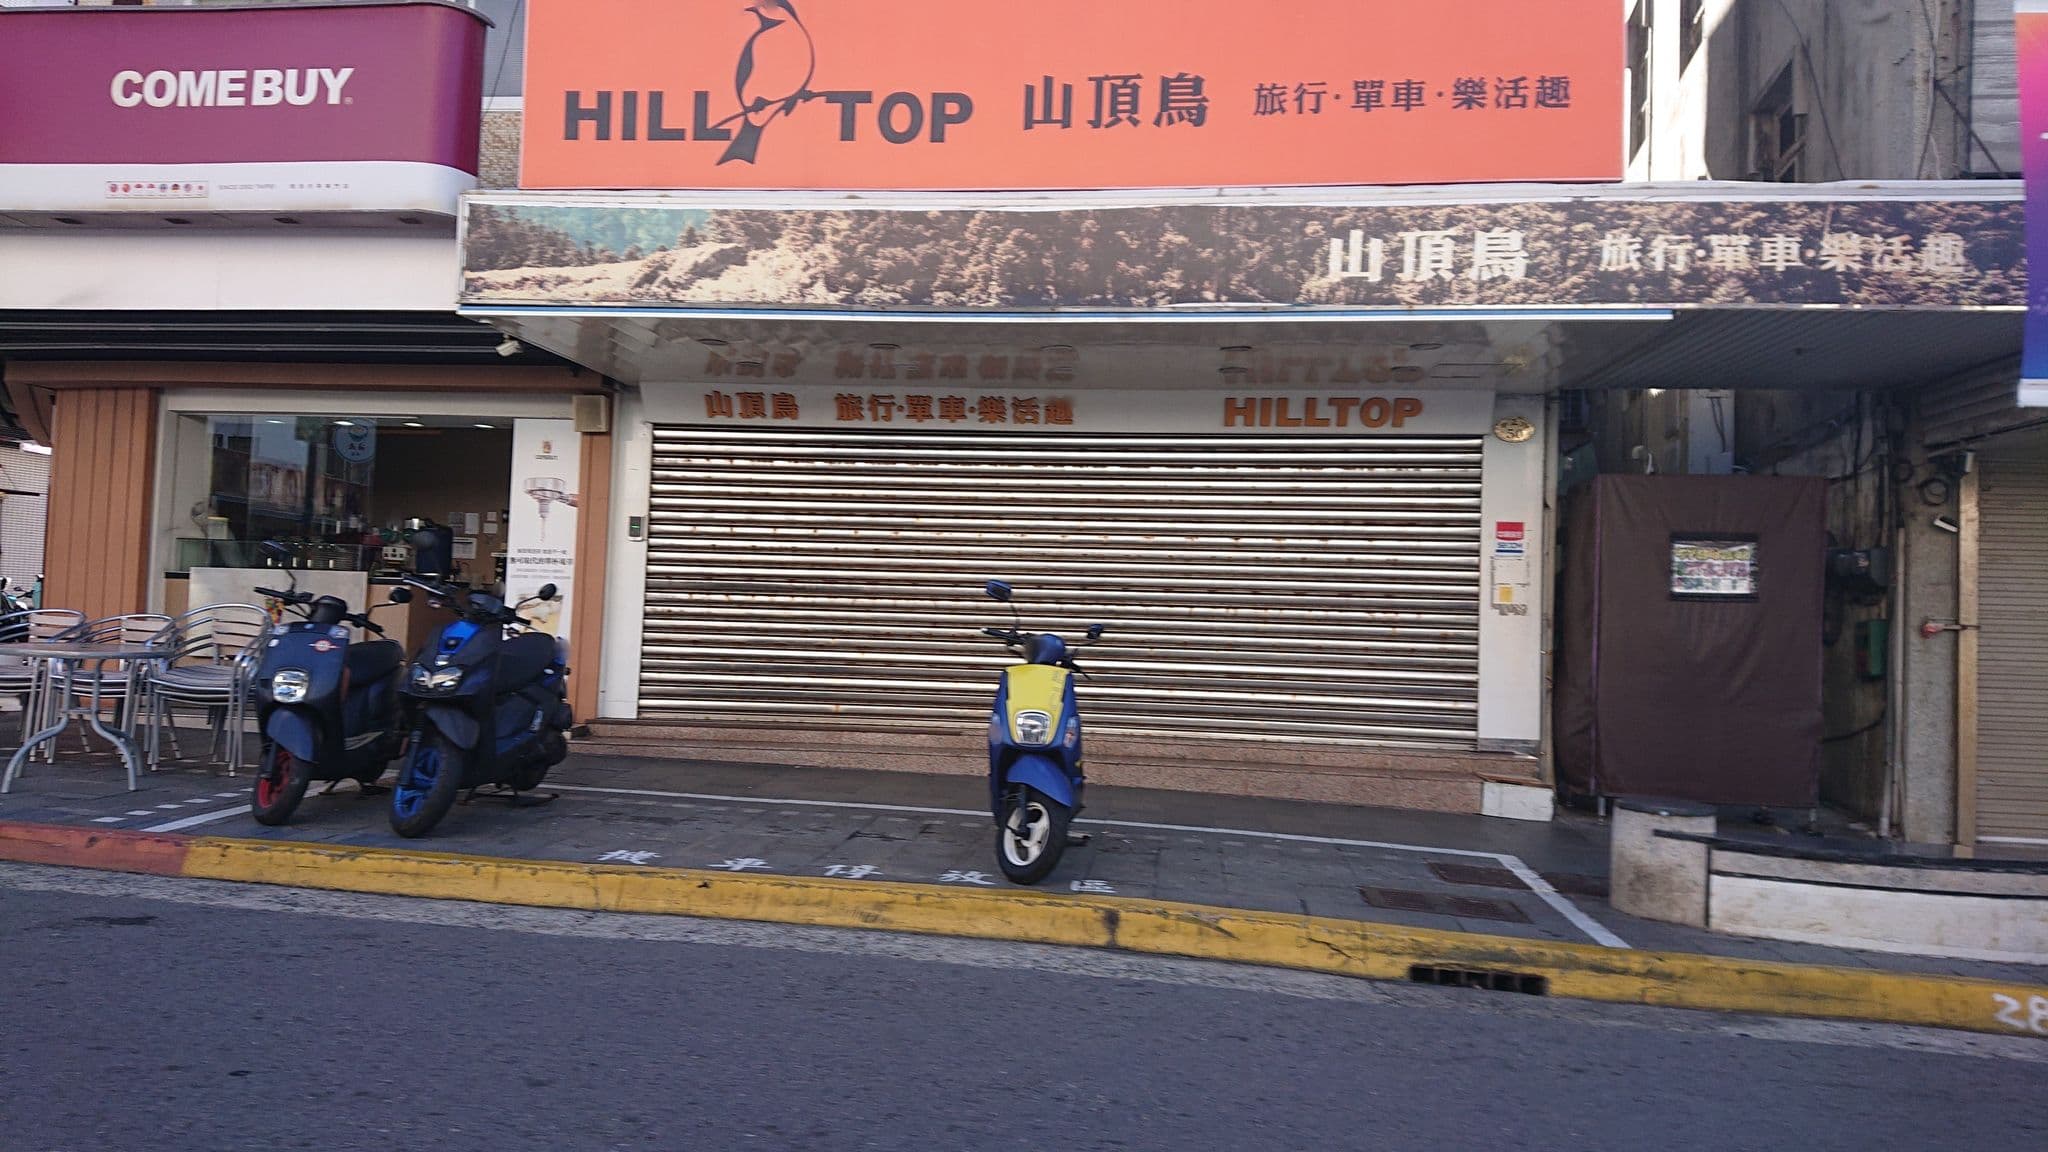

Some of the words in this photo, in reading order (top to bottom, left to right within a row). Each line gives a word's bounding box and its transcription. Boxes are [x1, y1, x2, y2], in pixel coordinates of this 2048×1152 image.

[564, 90, 732, 141] HILL
[826, 90, 974, 145] TOP
[1022, 72, 1209, 130] 山頂鳥
[1327, 229, 1528, 283] 山頂鳥
[704, 390, 799, 421] 山頂鳥
[1223, 397, 1424, 429] HILLTOP
